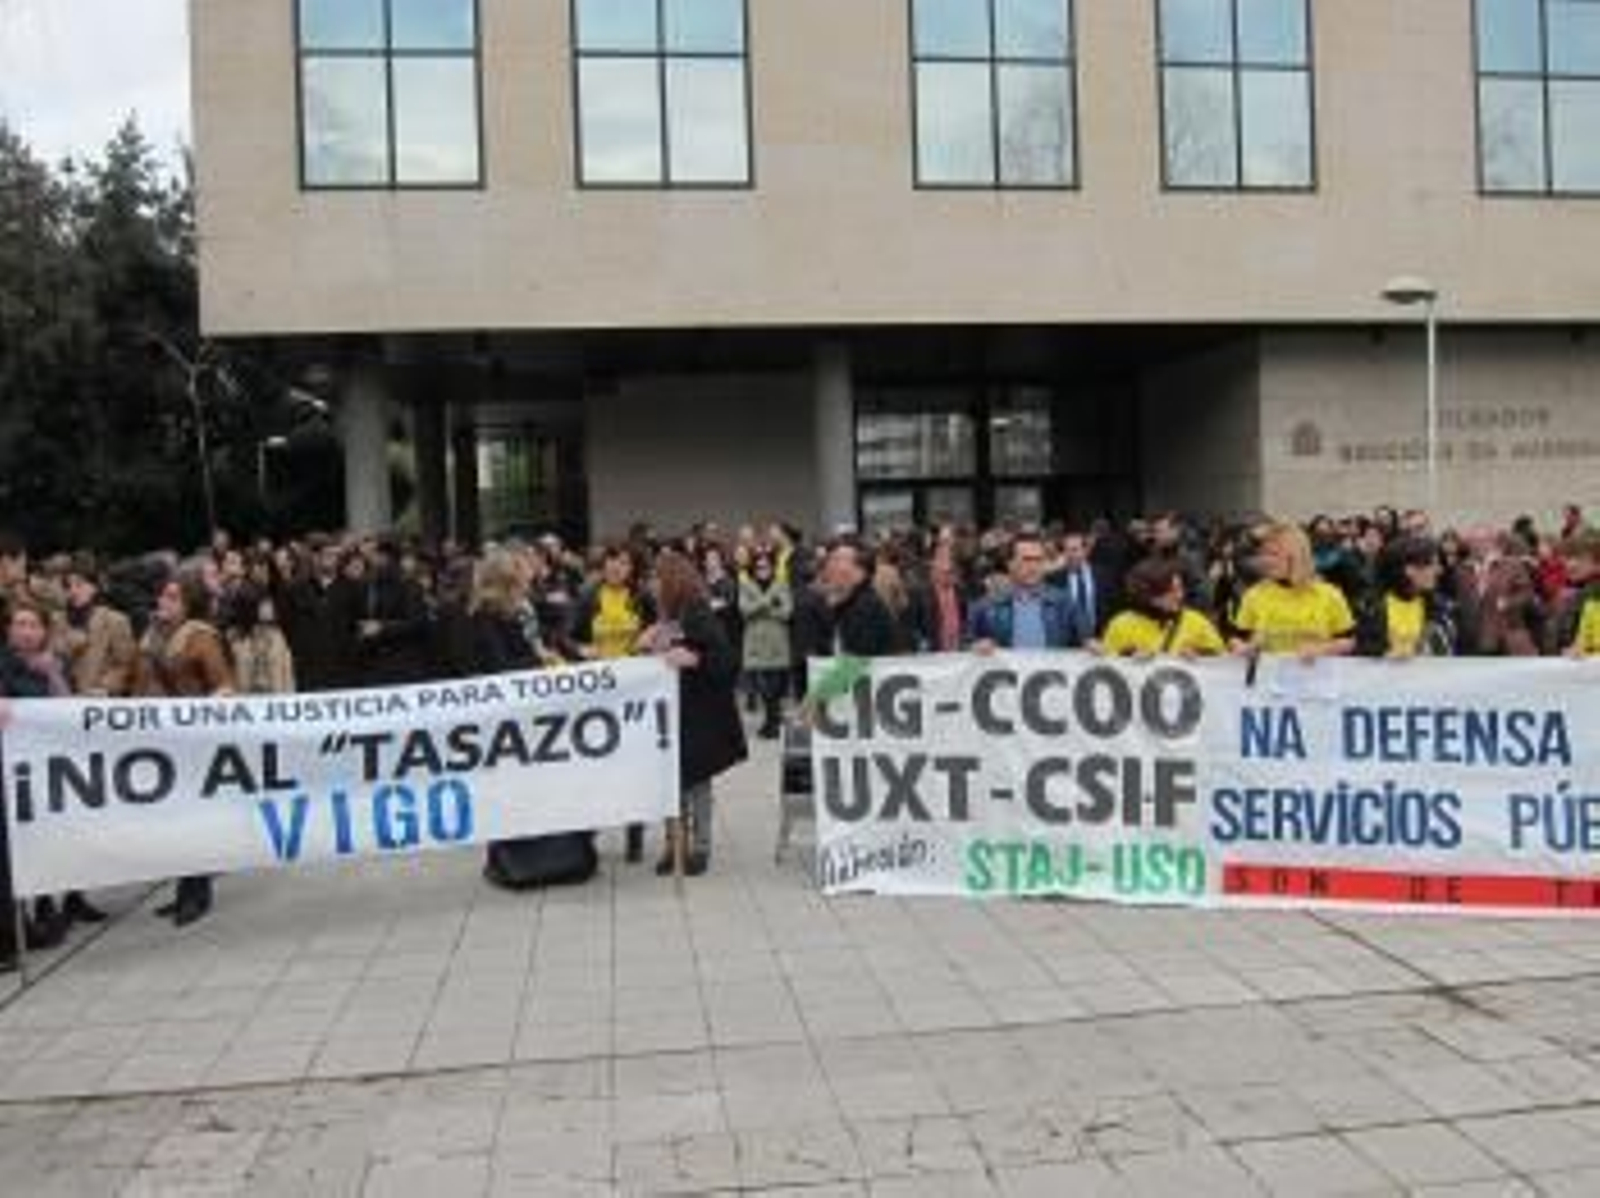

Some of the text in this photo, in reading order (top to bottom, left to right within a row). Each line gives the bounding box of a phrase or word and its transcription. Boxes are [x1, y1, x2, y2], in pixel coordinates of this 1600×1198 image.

[84, 667, 617, 731] POR UNA JUSTICIA PARA TODOS
[1240, 706, 1573, 767] NA DEFENSA
[14, 747, 177, 822] ¡NO
[199, 742, 298, 798] AL
[258, 779, 473, 862] VIGO
[1553, 878, 1600, 907] T
